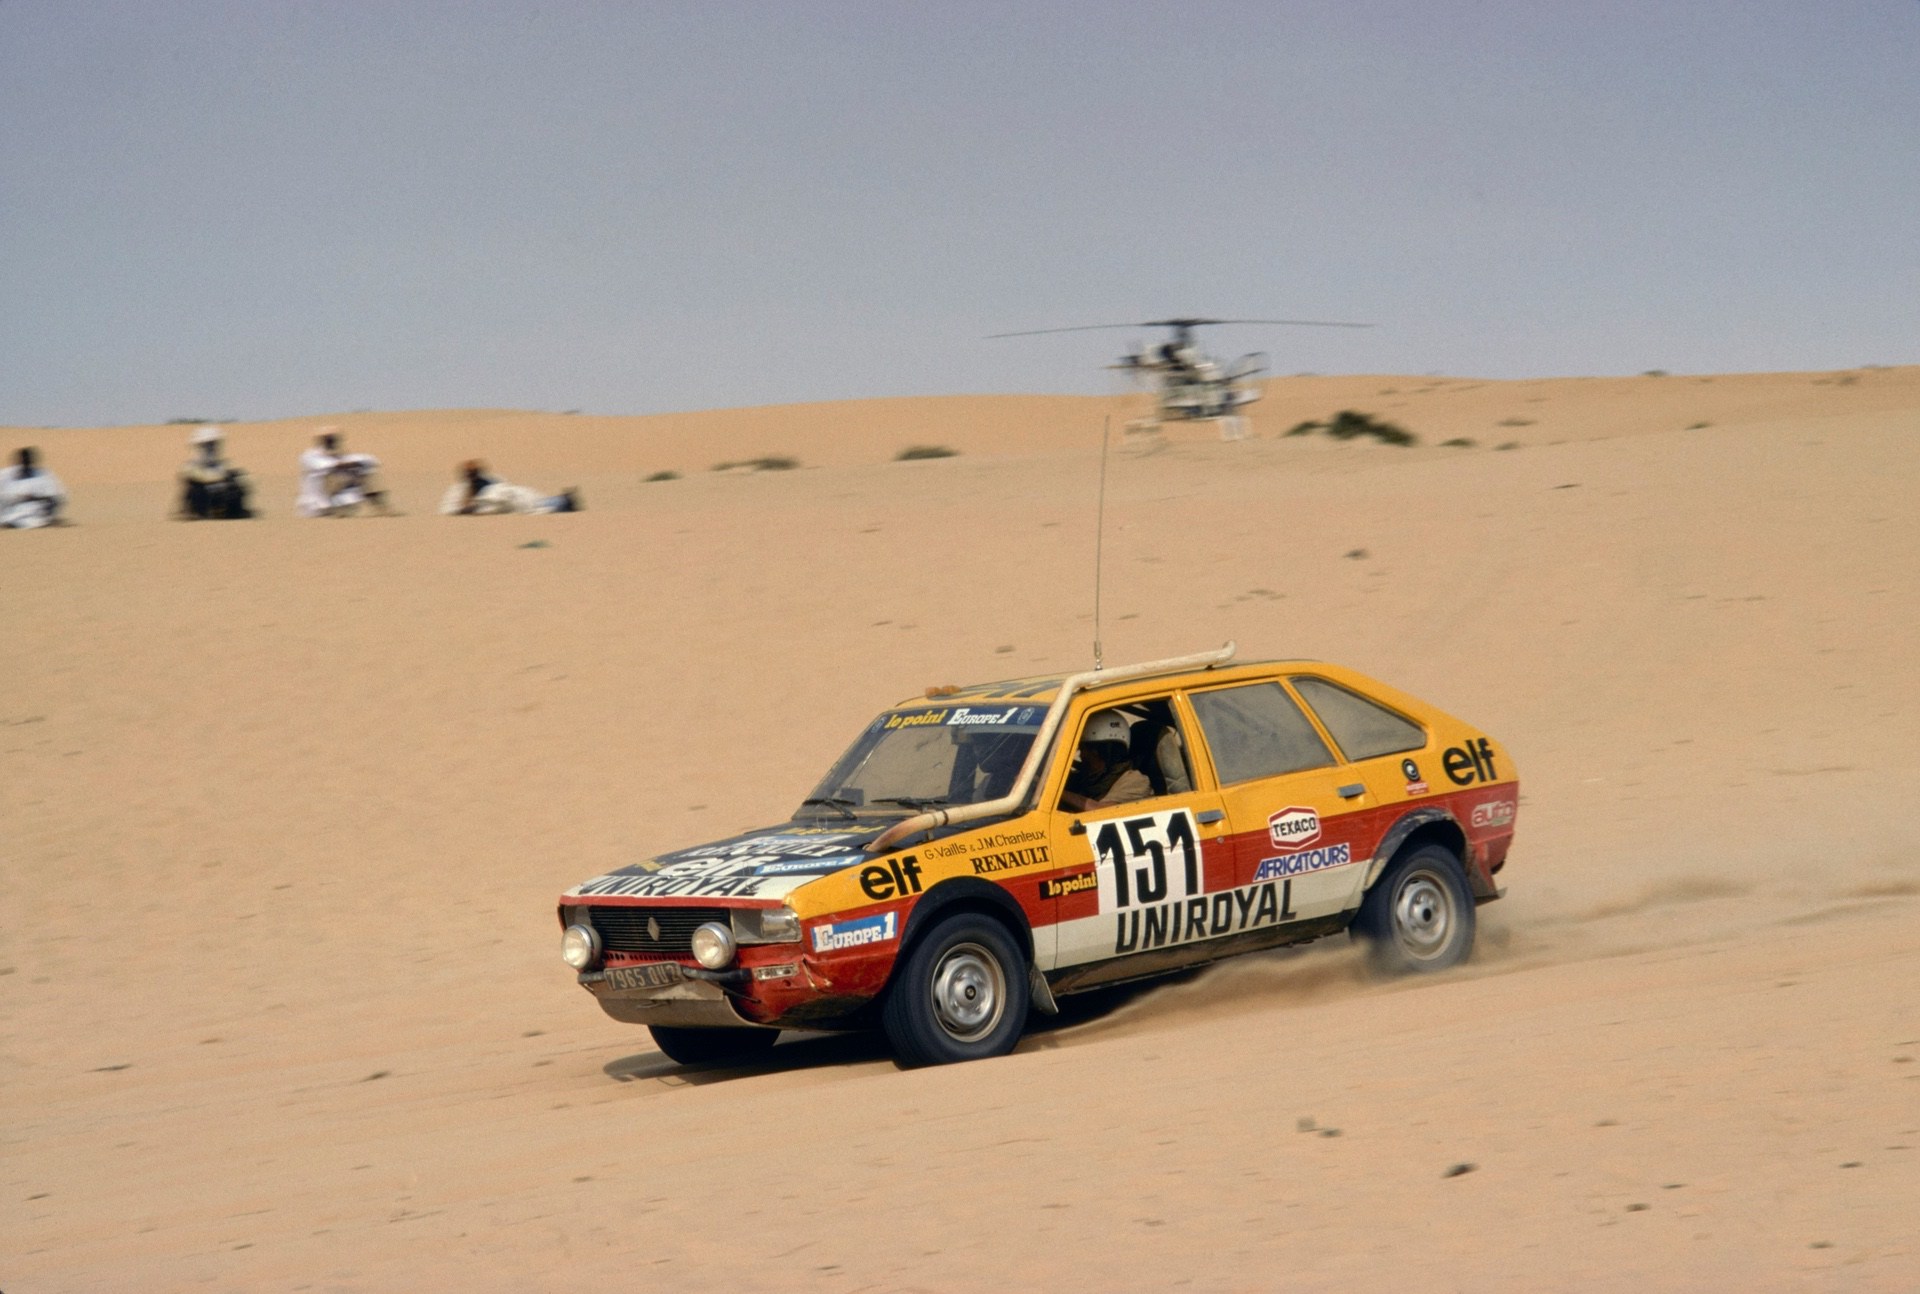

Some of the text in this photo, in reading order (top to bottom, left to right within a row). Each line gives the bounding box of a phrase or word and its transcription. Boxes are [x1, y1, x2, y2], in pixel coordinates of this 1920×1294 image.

[1442, 737, 1497, 786] elf
[1271, 816, 1317, 837] TEXACO
[657, 855, 781, 877] elf
[970, 845, 1050, 874] RENAULT
[1096, 811, 1199, 908] 151
[1253, 843, 1349, 881] AFRICATOURS
[579, 876, 769, 896] UNIROYAL
[859, 855, 923, 900] elf
[1062, 871, 1097, 896] point
[1115, 879, 1297, 954] UNIROYAL
[606, 967, 646, 990] 7965
